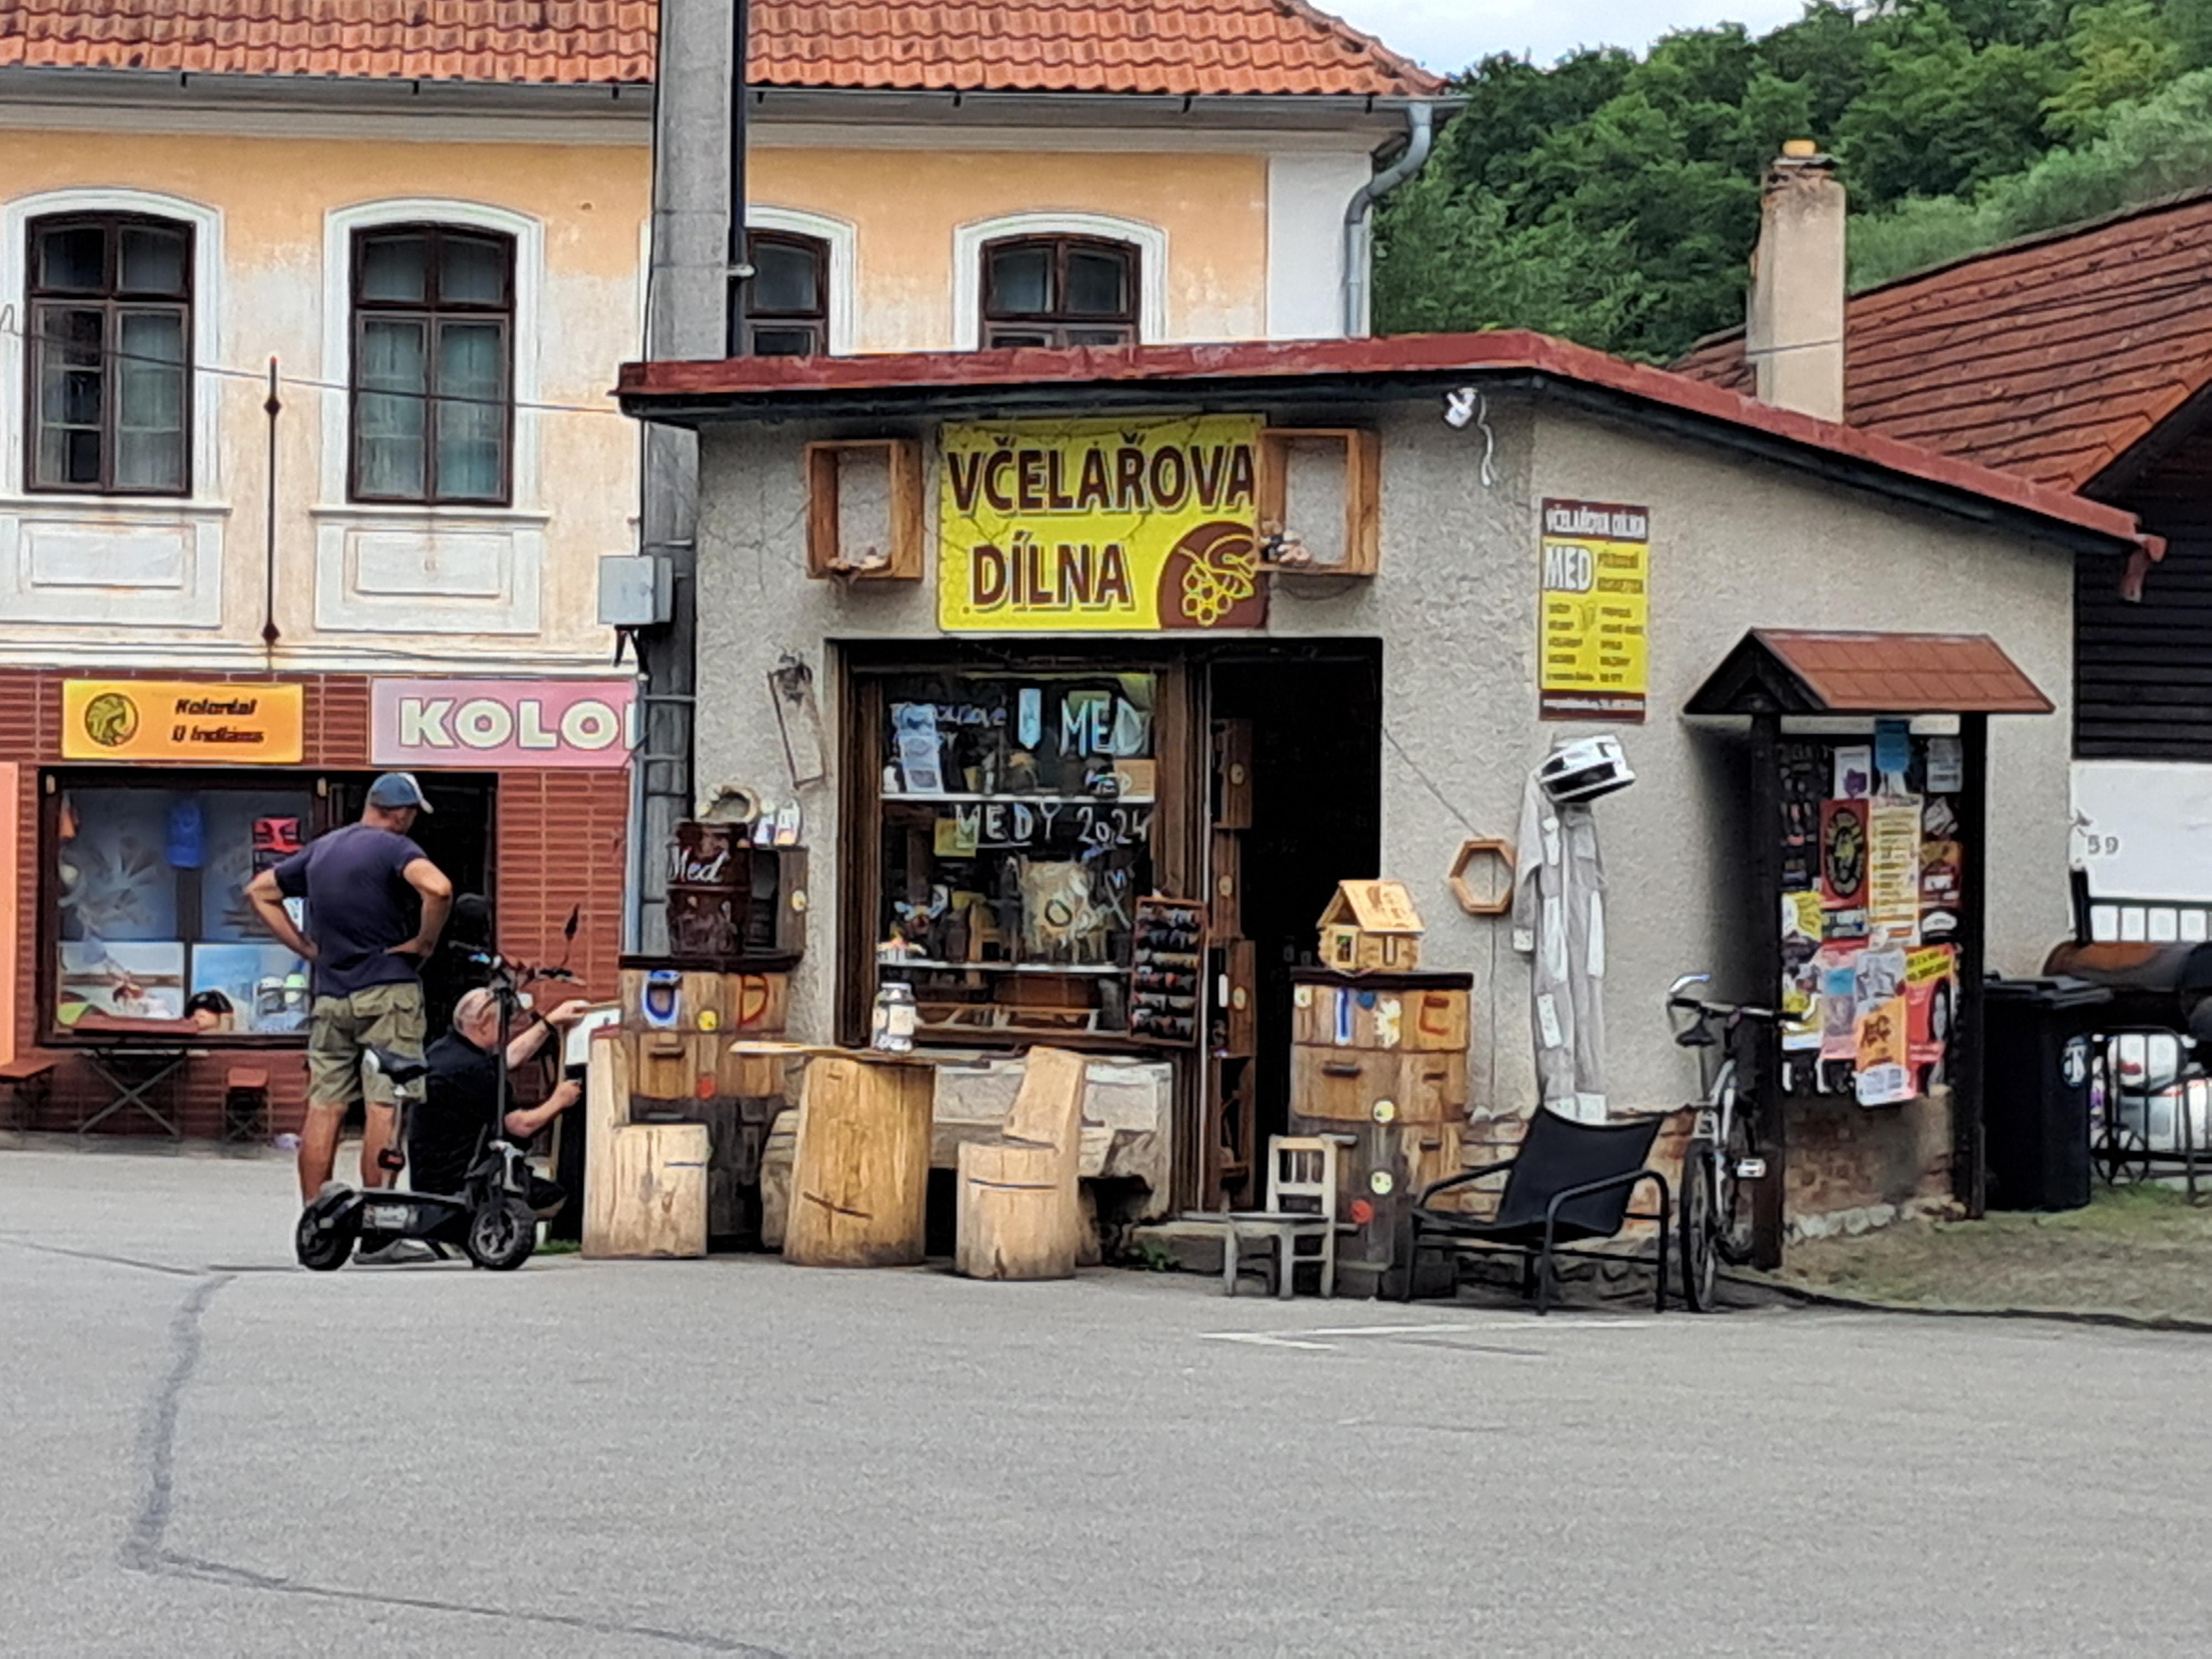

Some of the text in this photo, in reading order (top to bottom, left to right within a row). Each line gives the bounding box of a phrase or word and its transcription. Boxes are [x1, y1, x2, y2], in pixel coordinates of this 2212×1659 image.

[947, 431, 1255, 512] VČELAŘOVA
[972, 531, 1131, 607] DÍLNA
[1543, 544, 1593, 591] MED
[399, 698, 636, 750] KOLO
[1060, 696, 1143, 757] MED
[954, 801, 1062, 842] MEDY
[667, 846, 731, 883] Med
